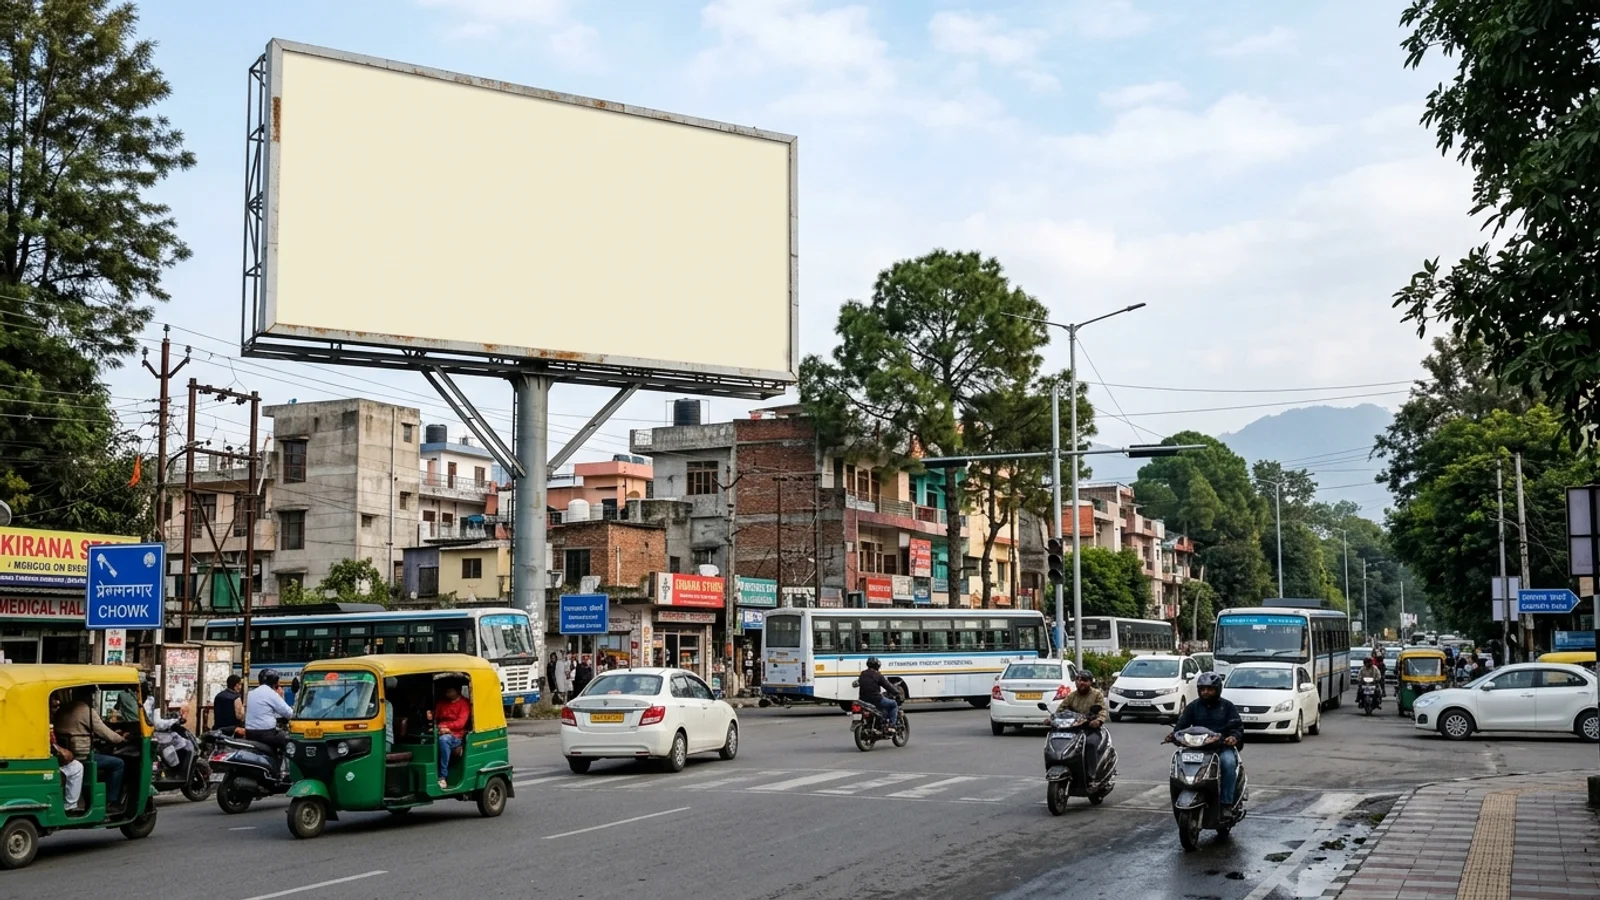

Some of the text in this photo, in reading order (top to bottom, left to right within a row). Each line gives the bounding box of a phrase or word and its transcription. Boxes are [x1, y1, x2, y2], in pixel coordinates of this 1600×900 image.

[1, 535, 74, 559] KIRANA
[53, 563, 66, 572] ON
[0, 599, 56, 615] MEDICAL
[98, 604, 149, 618] CHOWK
